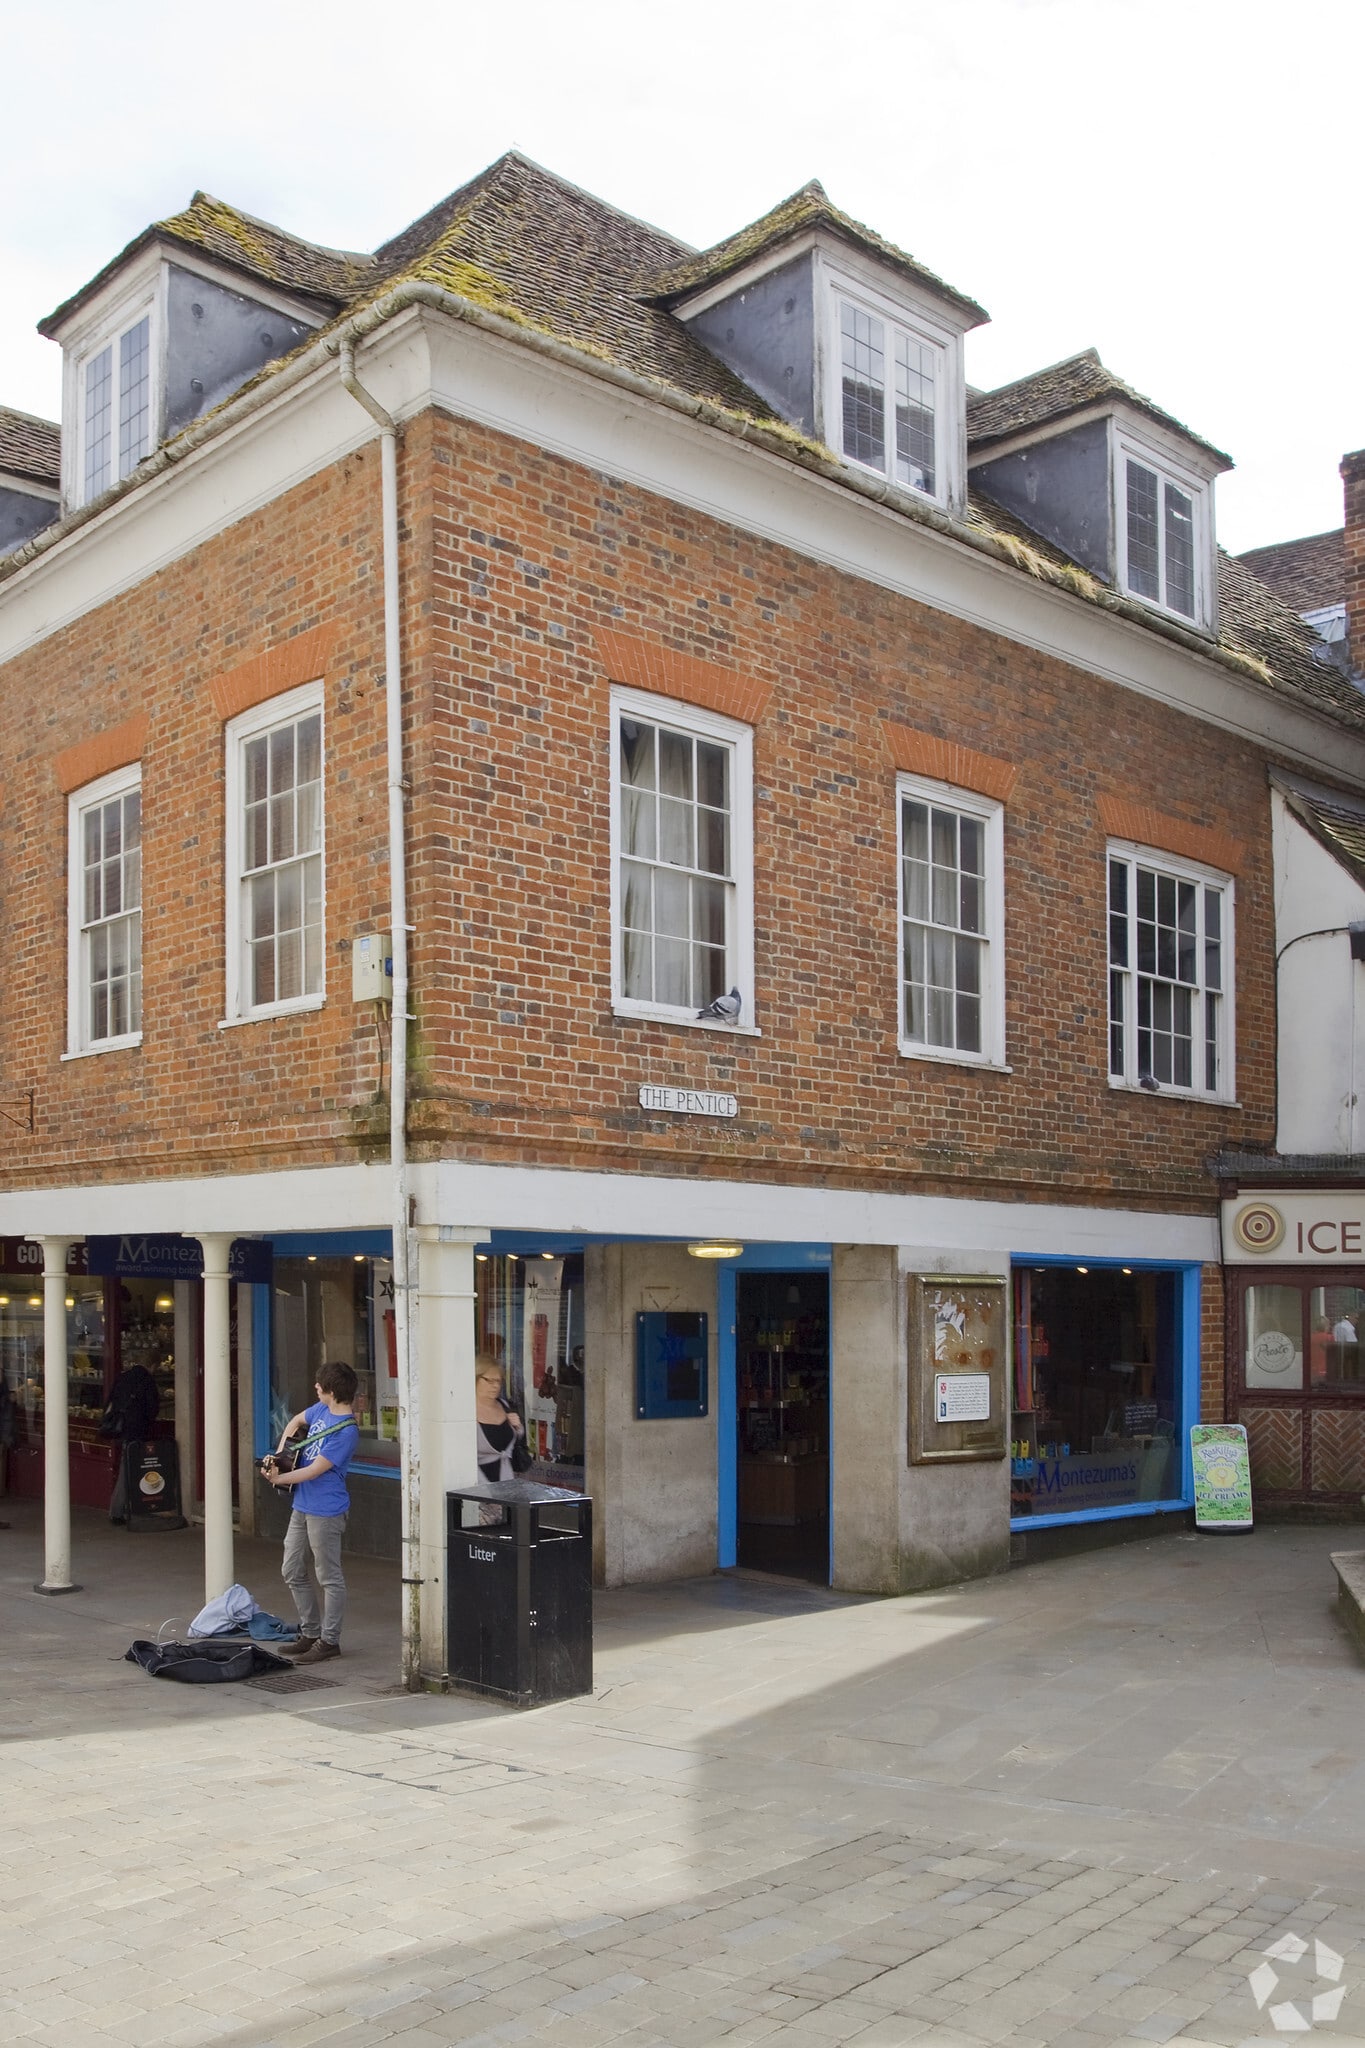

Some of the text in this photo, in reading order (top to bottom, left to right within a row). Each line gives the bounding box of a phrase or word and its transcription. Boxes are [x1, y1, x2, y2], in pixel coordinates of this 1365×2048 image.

[644, 1088, 735, 1115] THE PENTICE
[1296, 1221, 1363, 1254] ICE
[1035, 1458, 1136, 1494] Montezuma's
[1199, 1490, 1248, 1500] ICE CREAMS
[468, 1543, 497, 1562] Litter
